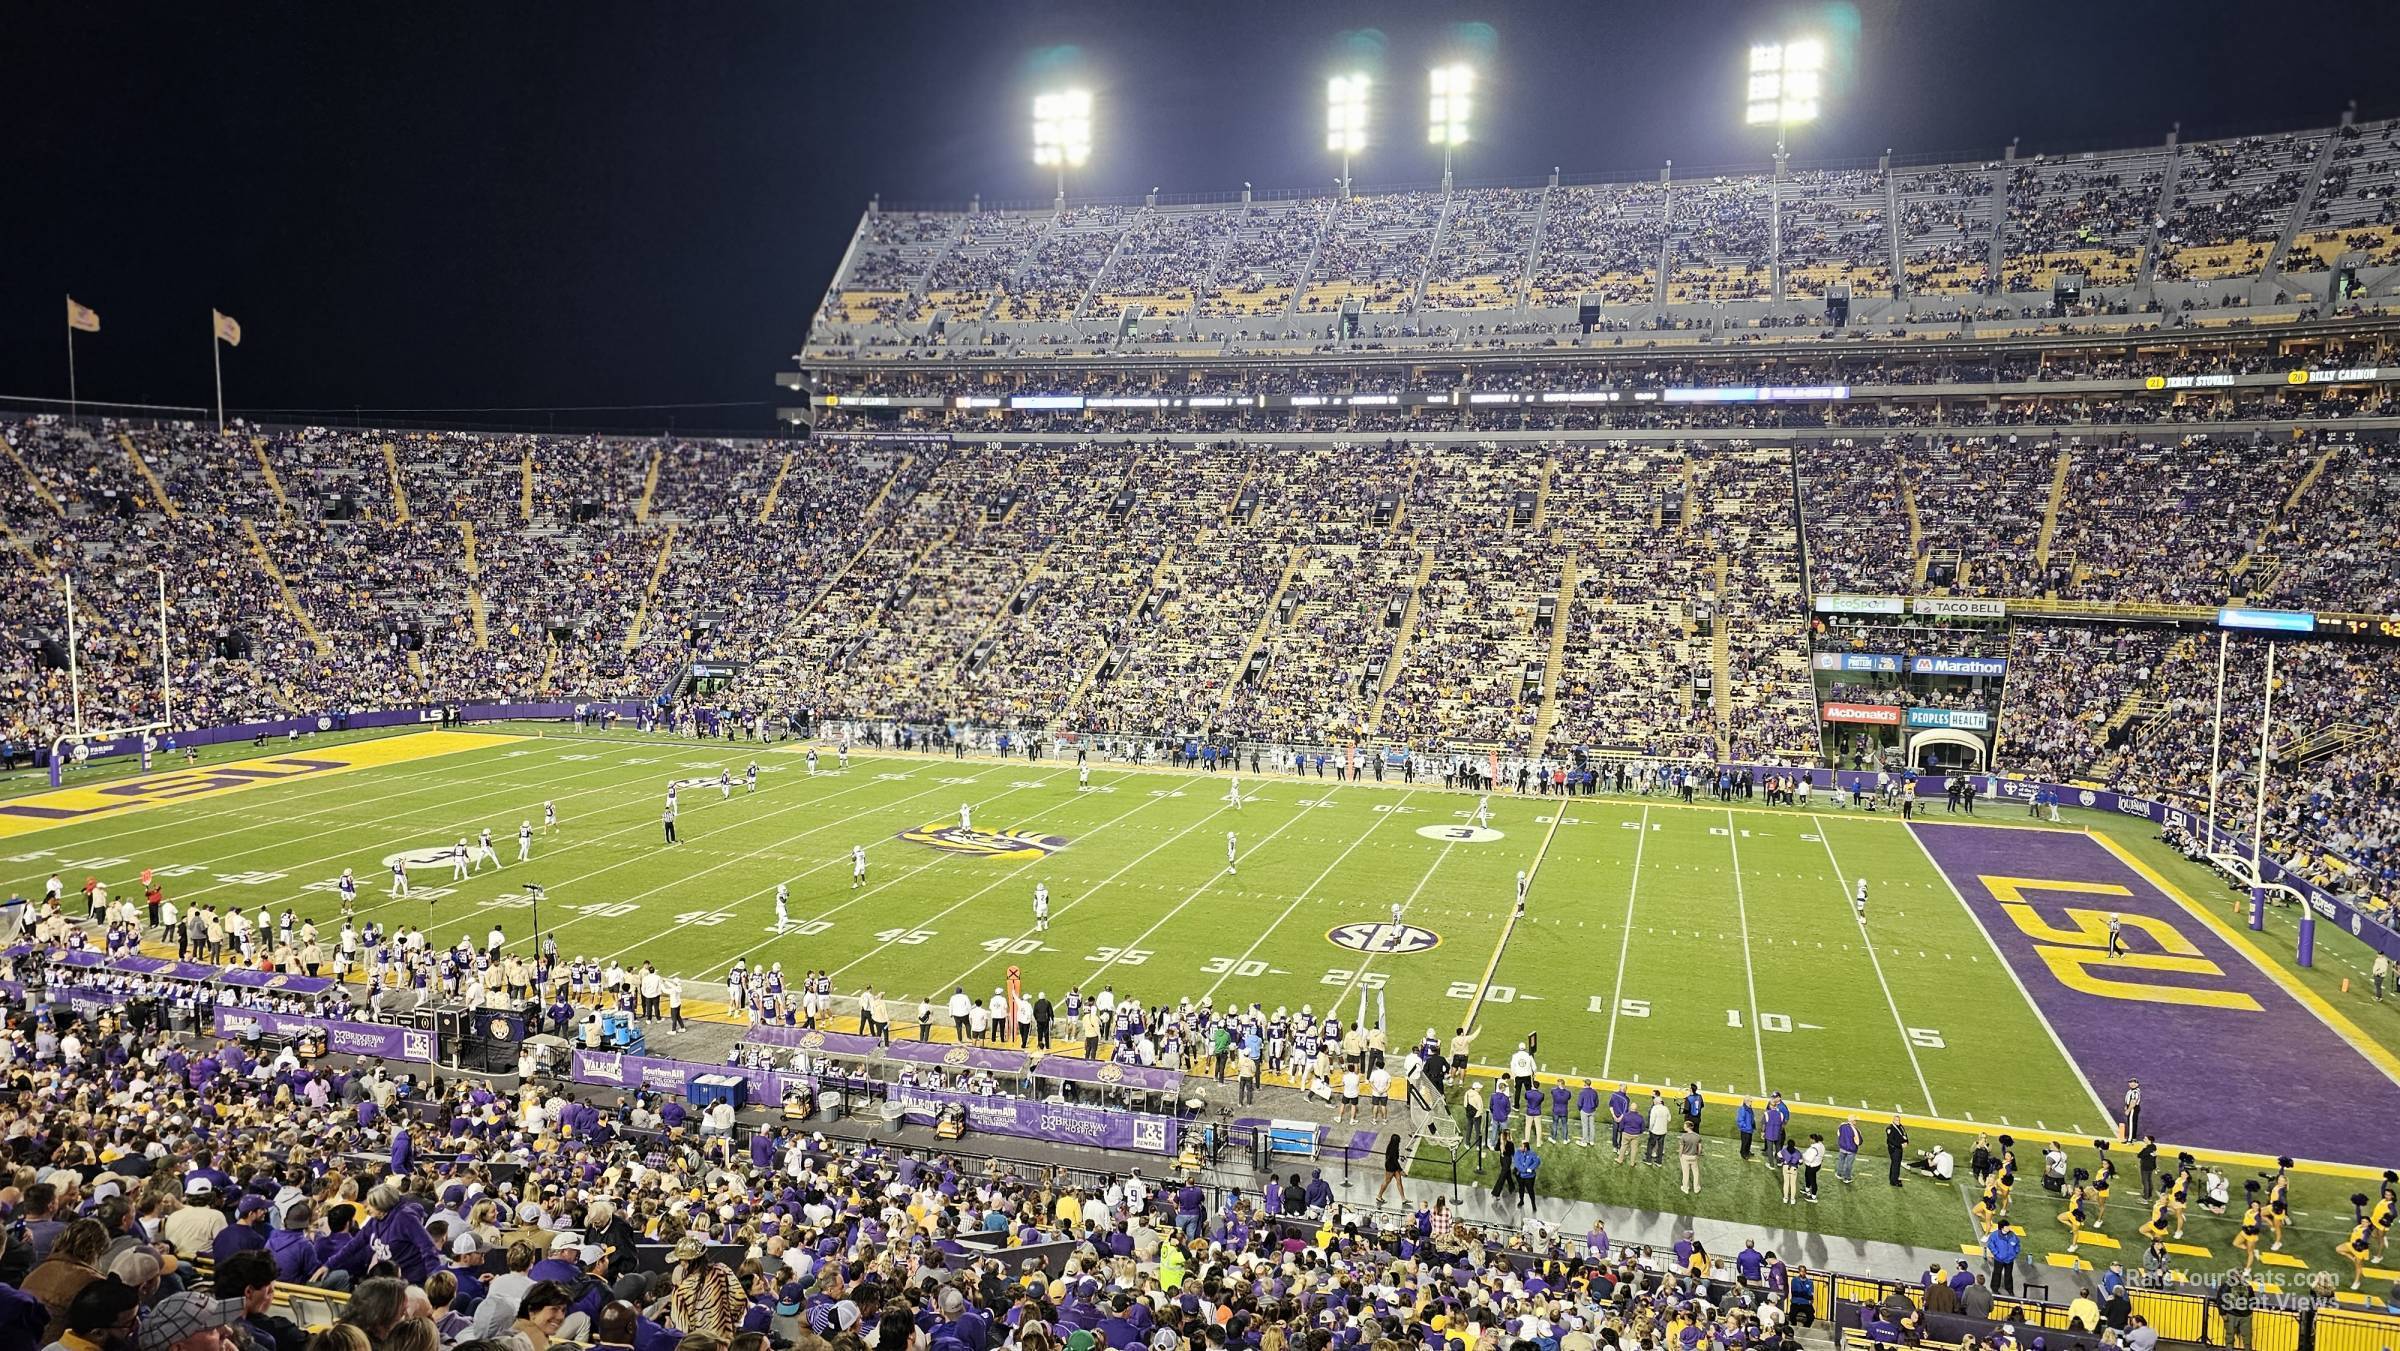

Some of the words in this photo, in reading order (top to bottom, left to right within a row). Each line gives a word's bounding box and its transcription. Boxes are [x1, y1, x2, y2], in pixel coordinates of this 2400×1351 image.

[2166, 378, 2193, 387] JERRY
[2196, 375, 2235, 387] STOVALL
[2309, 371, 2335, 381] BILLY
[2338, 369, 2377, 380] CANNON
[986, 442, 1002, 450] 300
[1608, 440, 1628, 448] 305
[1833, 438, 1853, 447] 410
[1966, 437, 1986, 446] 411
[1832, 598, 1886, 610] EcoSport
[1936, 603, 1968, 612] TACO
[1972, 604, 2000, 613] BELL
[1935, 660, 2002, 674] Marathon
[1827, 707, 1897, 720] McDonald's
[1912, 712, 1949, 724] PEOPLES
[1952, 713, 1985, 725] HEALTH
[674, 911, 737, 926] 45
[873, 928, 938, 945] 45
[1336, 924, 1435, 951] SEC
[1978, 874, 2266, 1012] LSU
[980, 937, 1044, 955] 40
[1084, 946, 1155, 966] 35
[1200, 957, 1269, 977] 30
[1320, 969, 1391, 989] 25
[819, 982, 830, 993] 97
[1446, 981, 1516, 1003] 20
[1069, 999, 1078, 1008] 19
[1586, 996, 1650, 1018] 15
[1726, 1009, 1793, 1033] 10
[345, 1031, 385, 1044] BRIDGEWAY
[1272, 1030, 1279, 1038] 4
[1325, 1027, 1337, 1037] 90
[1907, 1027, 1946, 1049] 5
[352, 1039, 377, 1048] HOSPICE
[583, 1057, 622, 1076] WALK-ON'S
[642, 1066, 685, 1078] SouthernAIR
[900, 1095, 943, 1112] WALK-ON'S
[969, 1103, 1017, 1118] SouthernAIR
[1055, 1116, 1107, 1132] BRIDGEWAY
[1065, 1125, 1097, 1137] HOSPICE
[1135, 1139, 1162, 1148] RENTALS
[1130, 1189, 1137, 1202] 9
